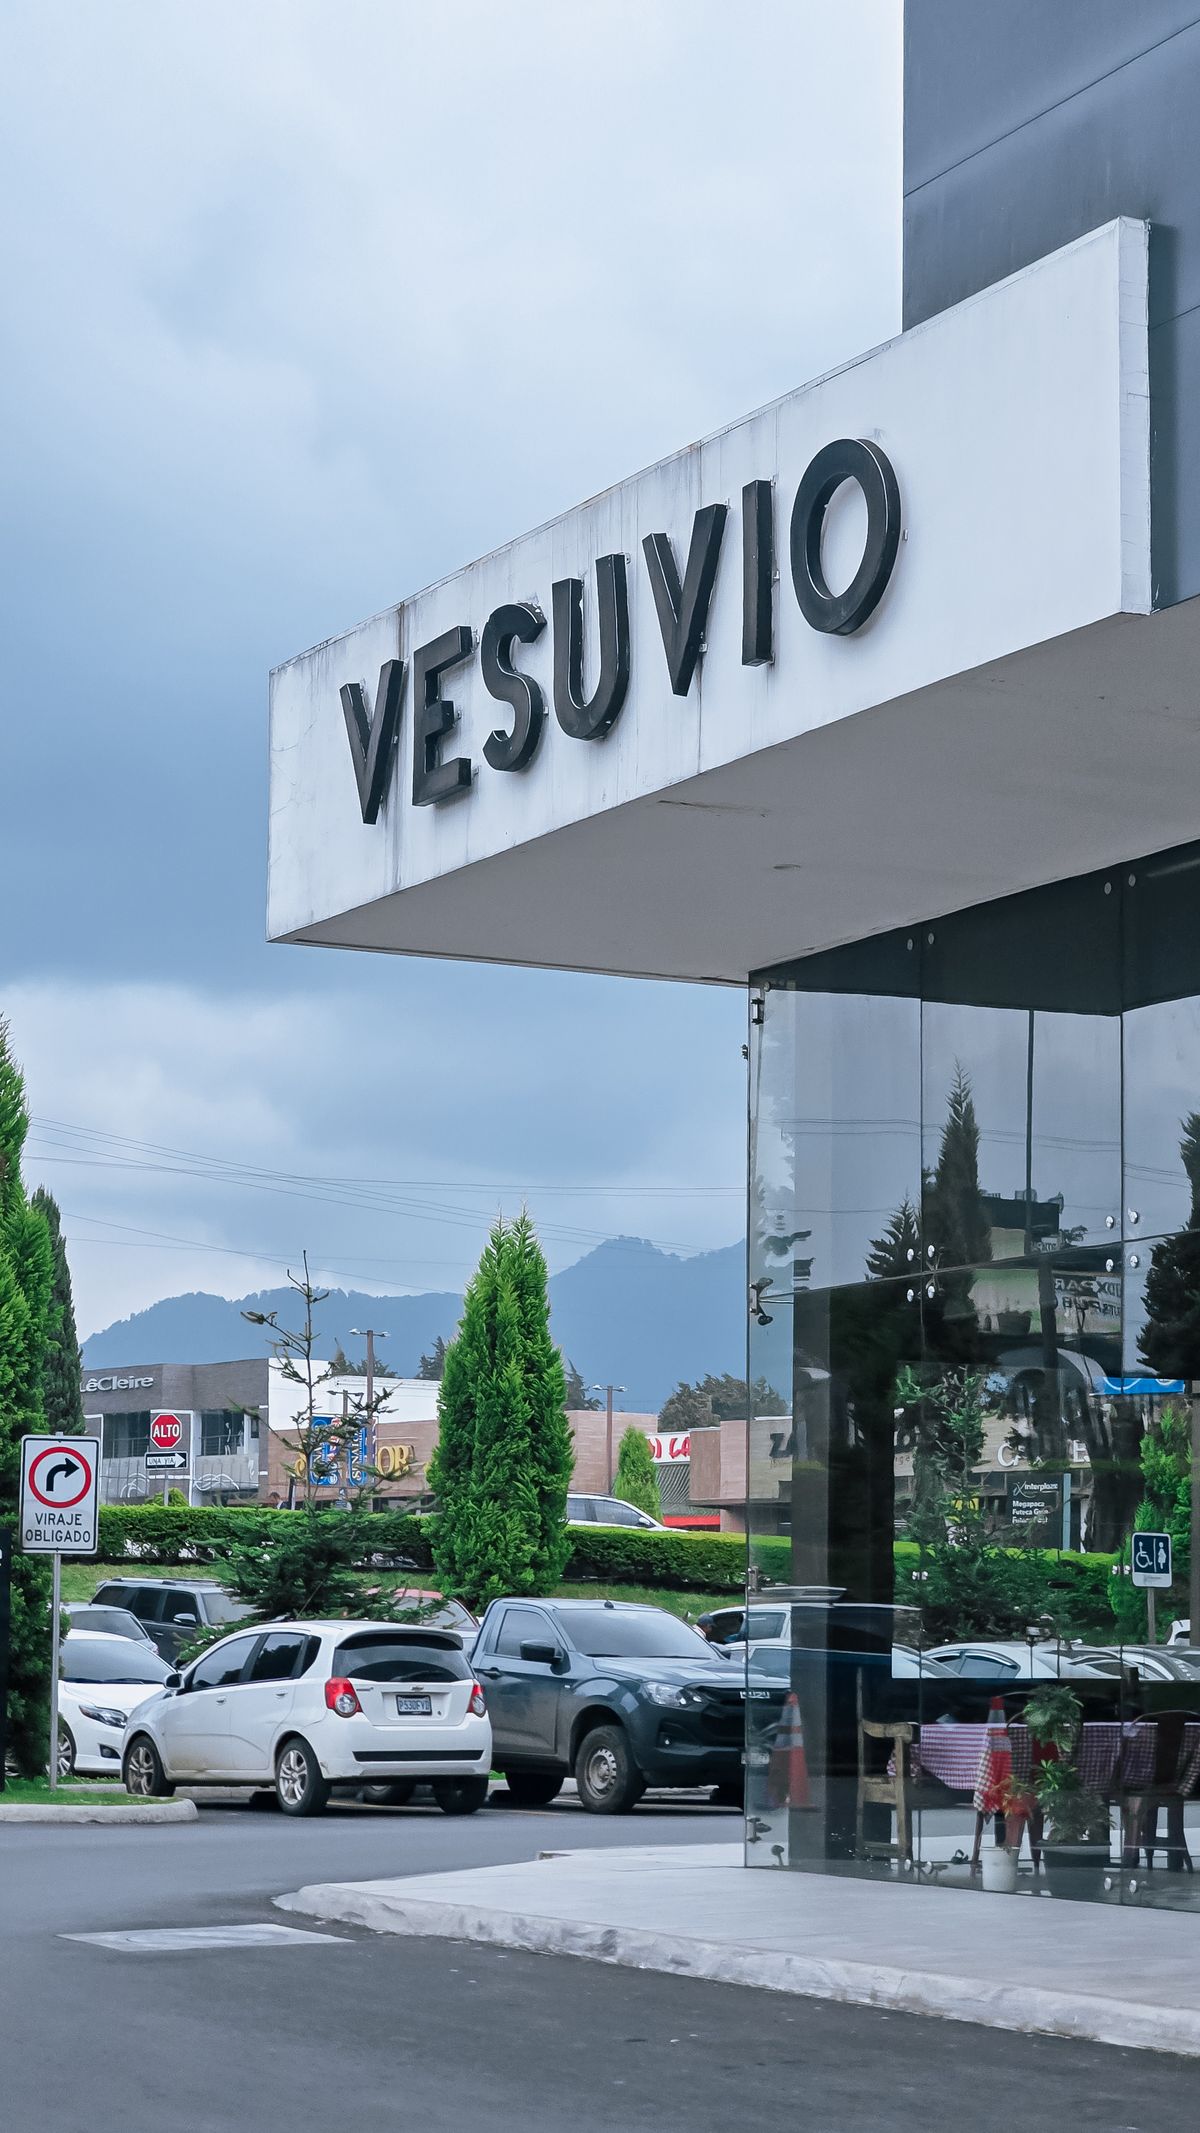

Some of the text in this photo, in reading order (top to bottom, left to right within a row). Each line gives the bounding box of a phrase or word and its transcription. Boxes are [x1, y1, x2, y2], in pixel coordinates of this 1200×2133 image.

[339, 438, 903, 825] VESUVIO
[152, 1424, 180, 1438] ALTO
[148, 1457, 161, 1465] UNA
[1012, 1500, 1045, 1508] Megapaca
[35, 1513, 82, 1526] VIRAJE
[25, 1529, 91, 1543] OBLIGADO
